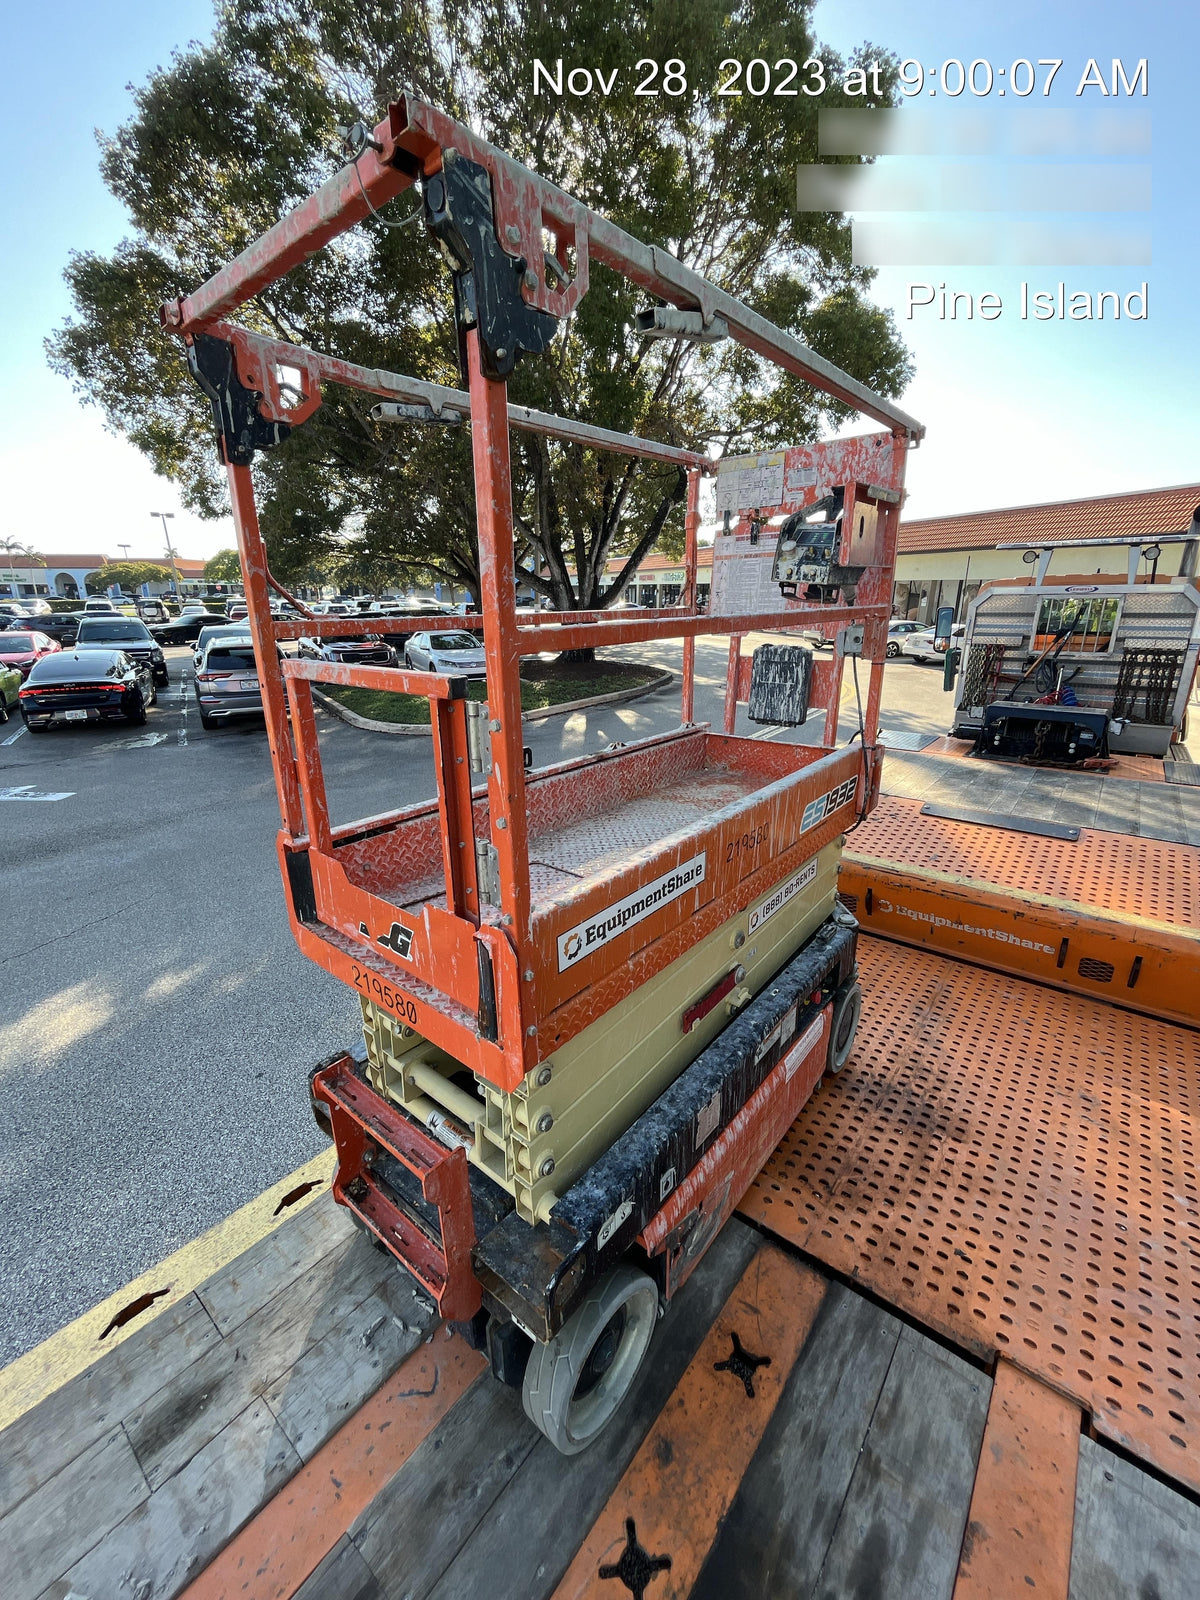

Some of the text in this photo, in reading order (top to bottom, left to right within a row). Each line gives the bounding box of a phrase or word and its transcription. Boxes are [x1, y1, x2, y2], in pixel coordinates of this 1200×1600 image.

[801, 776, 857, 832] ES1932
[726, 822, 770, 864] 219580
[585, 863, 703, 947] EquipmentShare
[762, 864, 816, 918] (888) 80-RENTS
[895, 903, 1057, 955] EquipmentShare
[351, 965, 417, 1025] 219580
